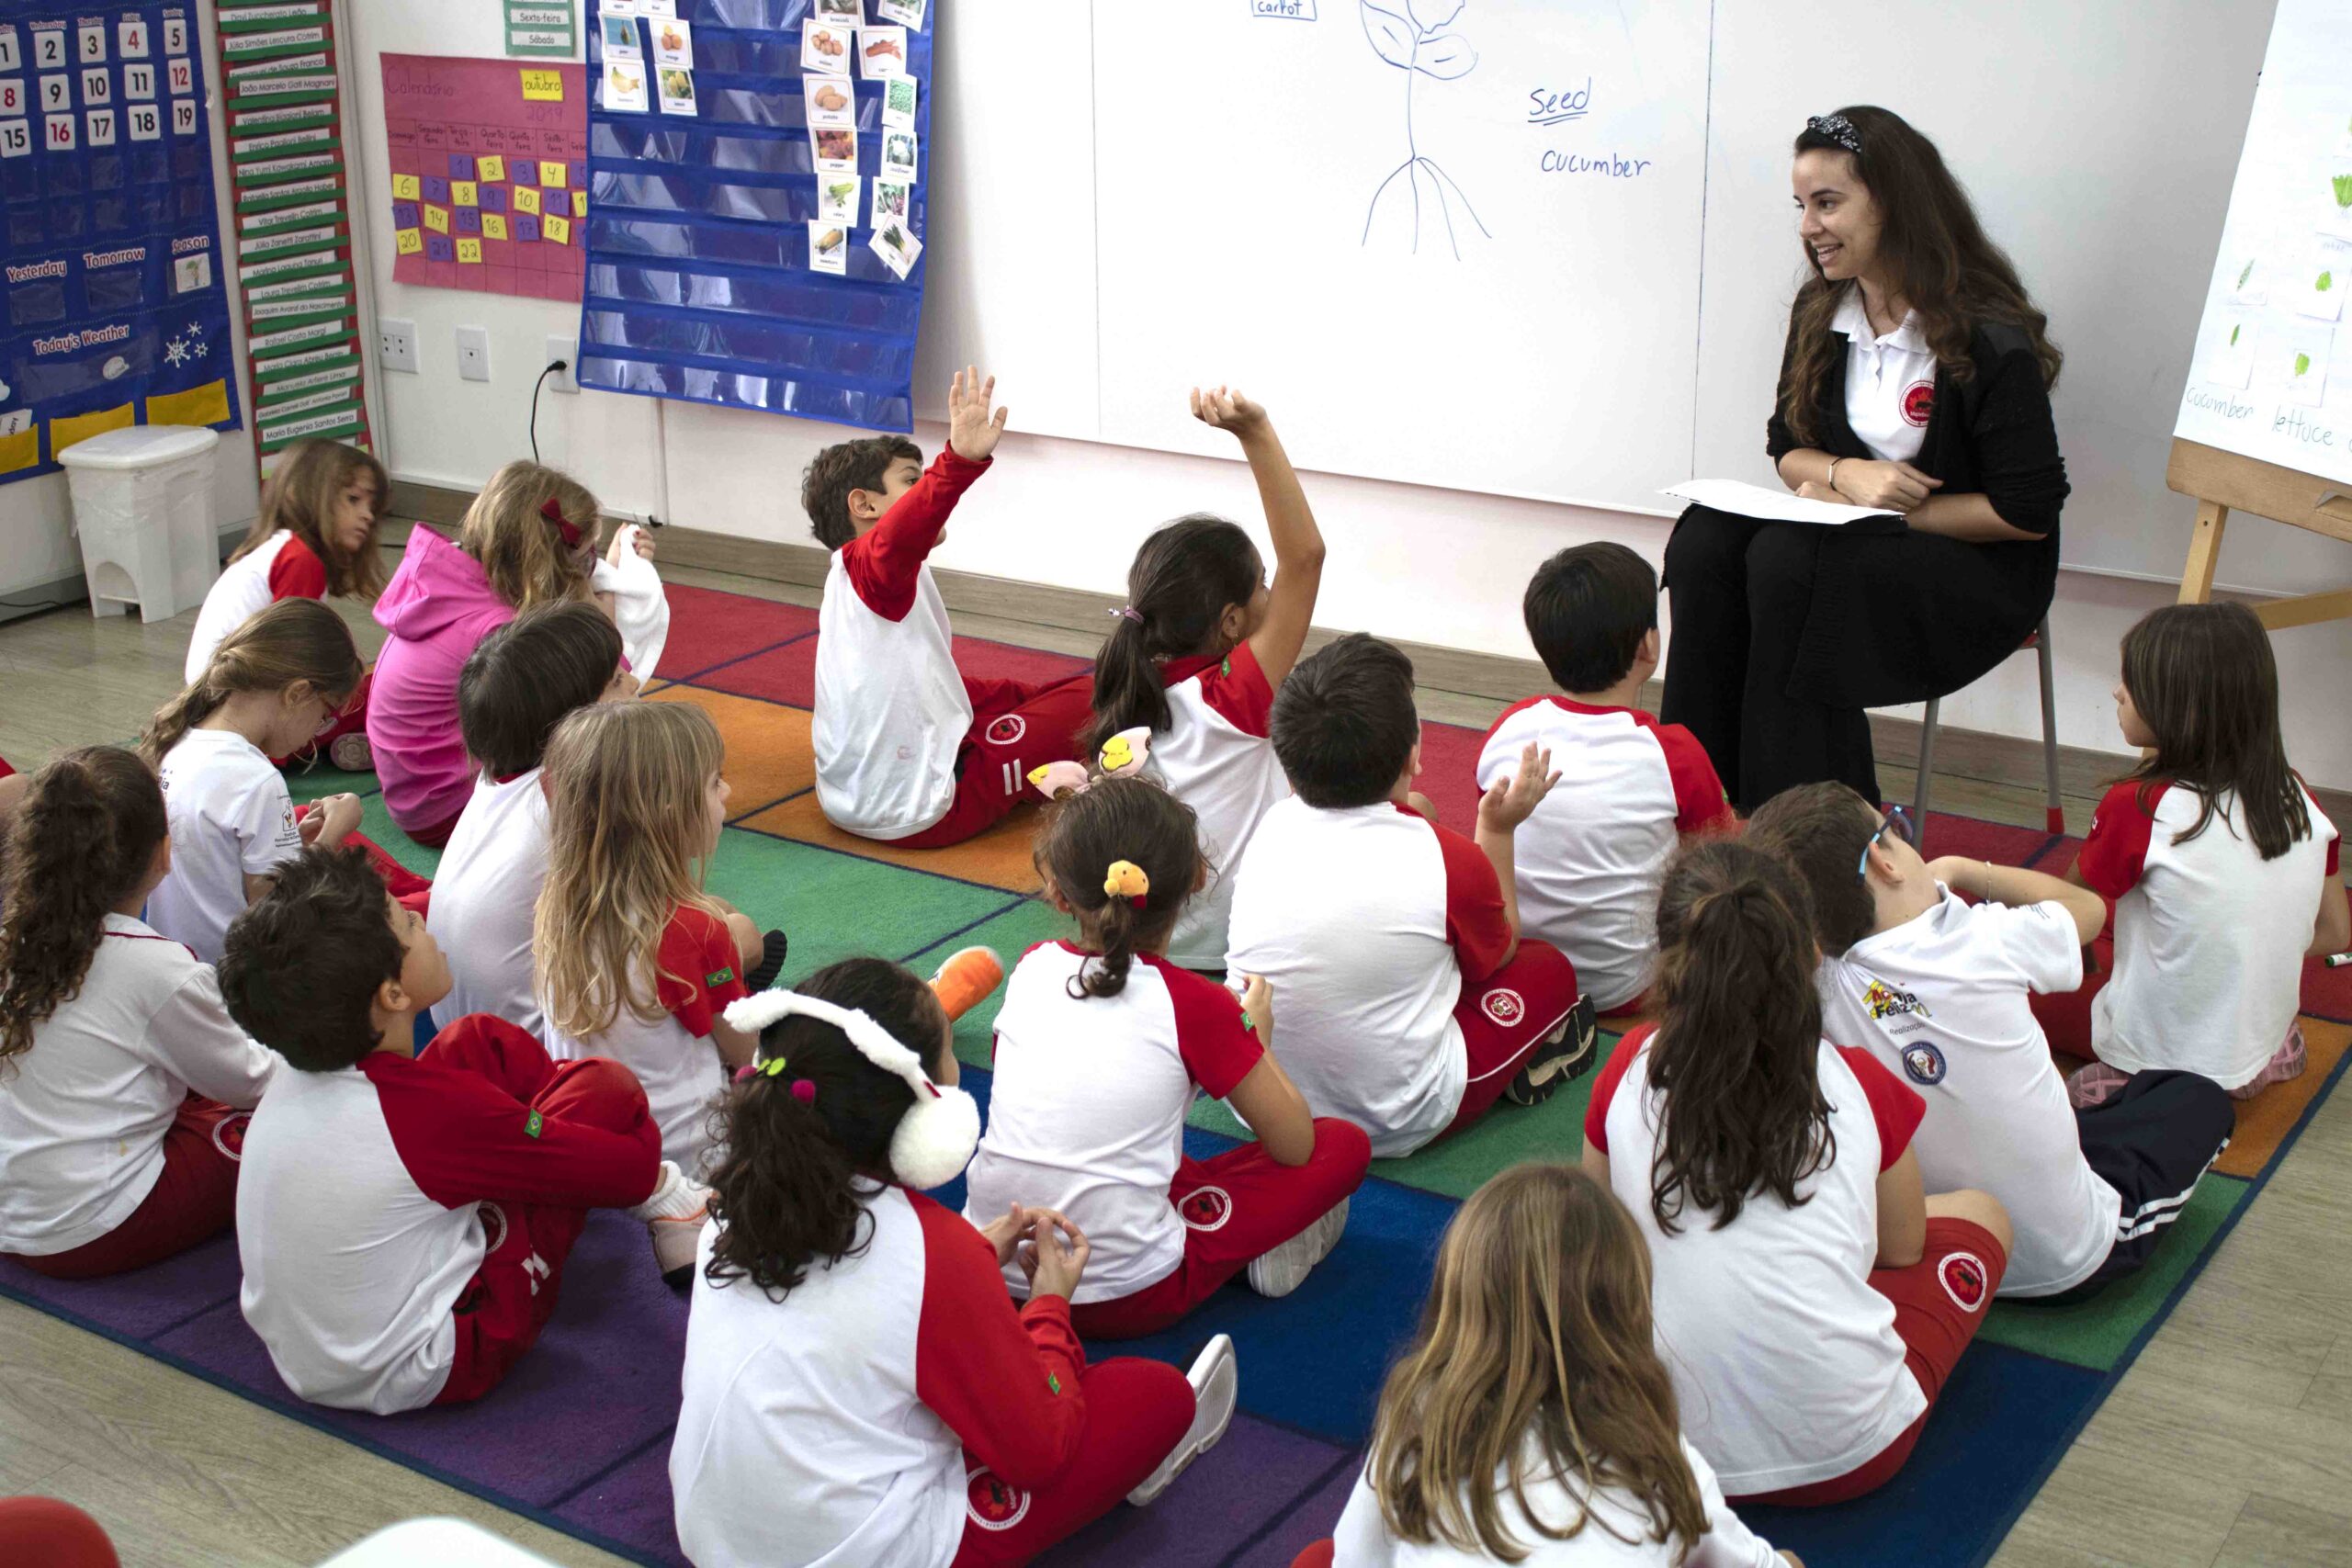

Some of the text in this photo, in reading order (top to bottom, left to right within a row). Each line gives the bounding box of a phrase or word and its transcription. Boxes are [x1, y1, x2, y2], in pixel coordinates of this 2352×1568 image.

[44, 39, 57, 61] 2
[87, 35, 99, 55] 3
[127, 29, 141, 51] 4
[171, 28, 181, 48] 5
[3, 66, 189, 108] 8 9 10 11 12
[525, 73, 560, 92] outubro
[1529, 76, 1591, 116] Seed
[4, 107, 193, 149] 15 16 17 18 19
[486, 161, 499, 177] 2
[519, 163, 530, 180] 3
[547, 165, 557, 182] 4
[400, 177, 411, 197] 6
[430, 180, 441, 196] 7
[461, 186, 471, 203] 8
[486, 189, 495, 206] 9
[516, 189, 534, 208] 10
[549, 191, 563, 209] 11
[400, 207, 414, 223] 13
[428, 209, 444, 225] 14
[460, 210, 476, 226] 15
[485, 217, 500, 234] 16
[518, 220, 534, 236] 17
[548, 219, 562, 236] 18
[84, 247, 145, 268] Tomorrow
[172, 235, 209, 254] Season
[400, 231, 479, 259] 20 21 22
[6, 260, 67, 283] Yesterday
[33, 324, 130, 355] Today's Weather
[2271, 404, 2334, 446] lettuce
[1876, 1000, 1912, 1020] Feliz
